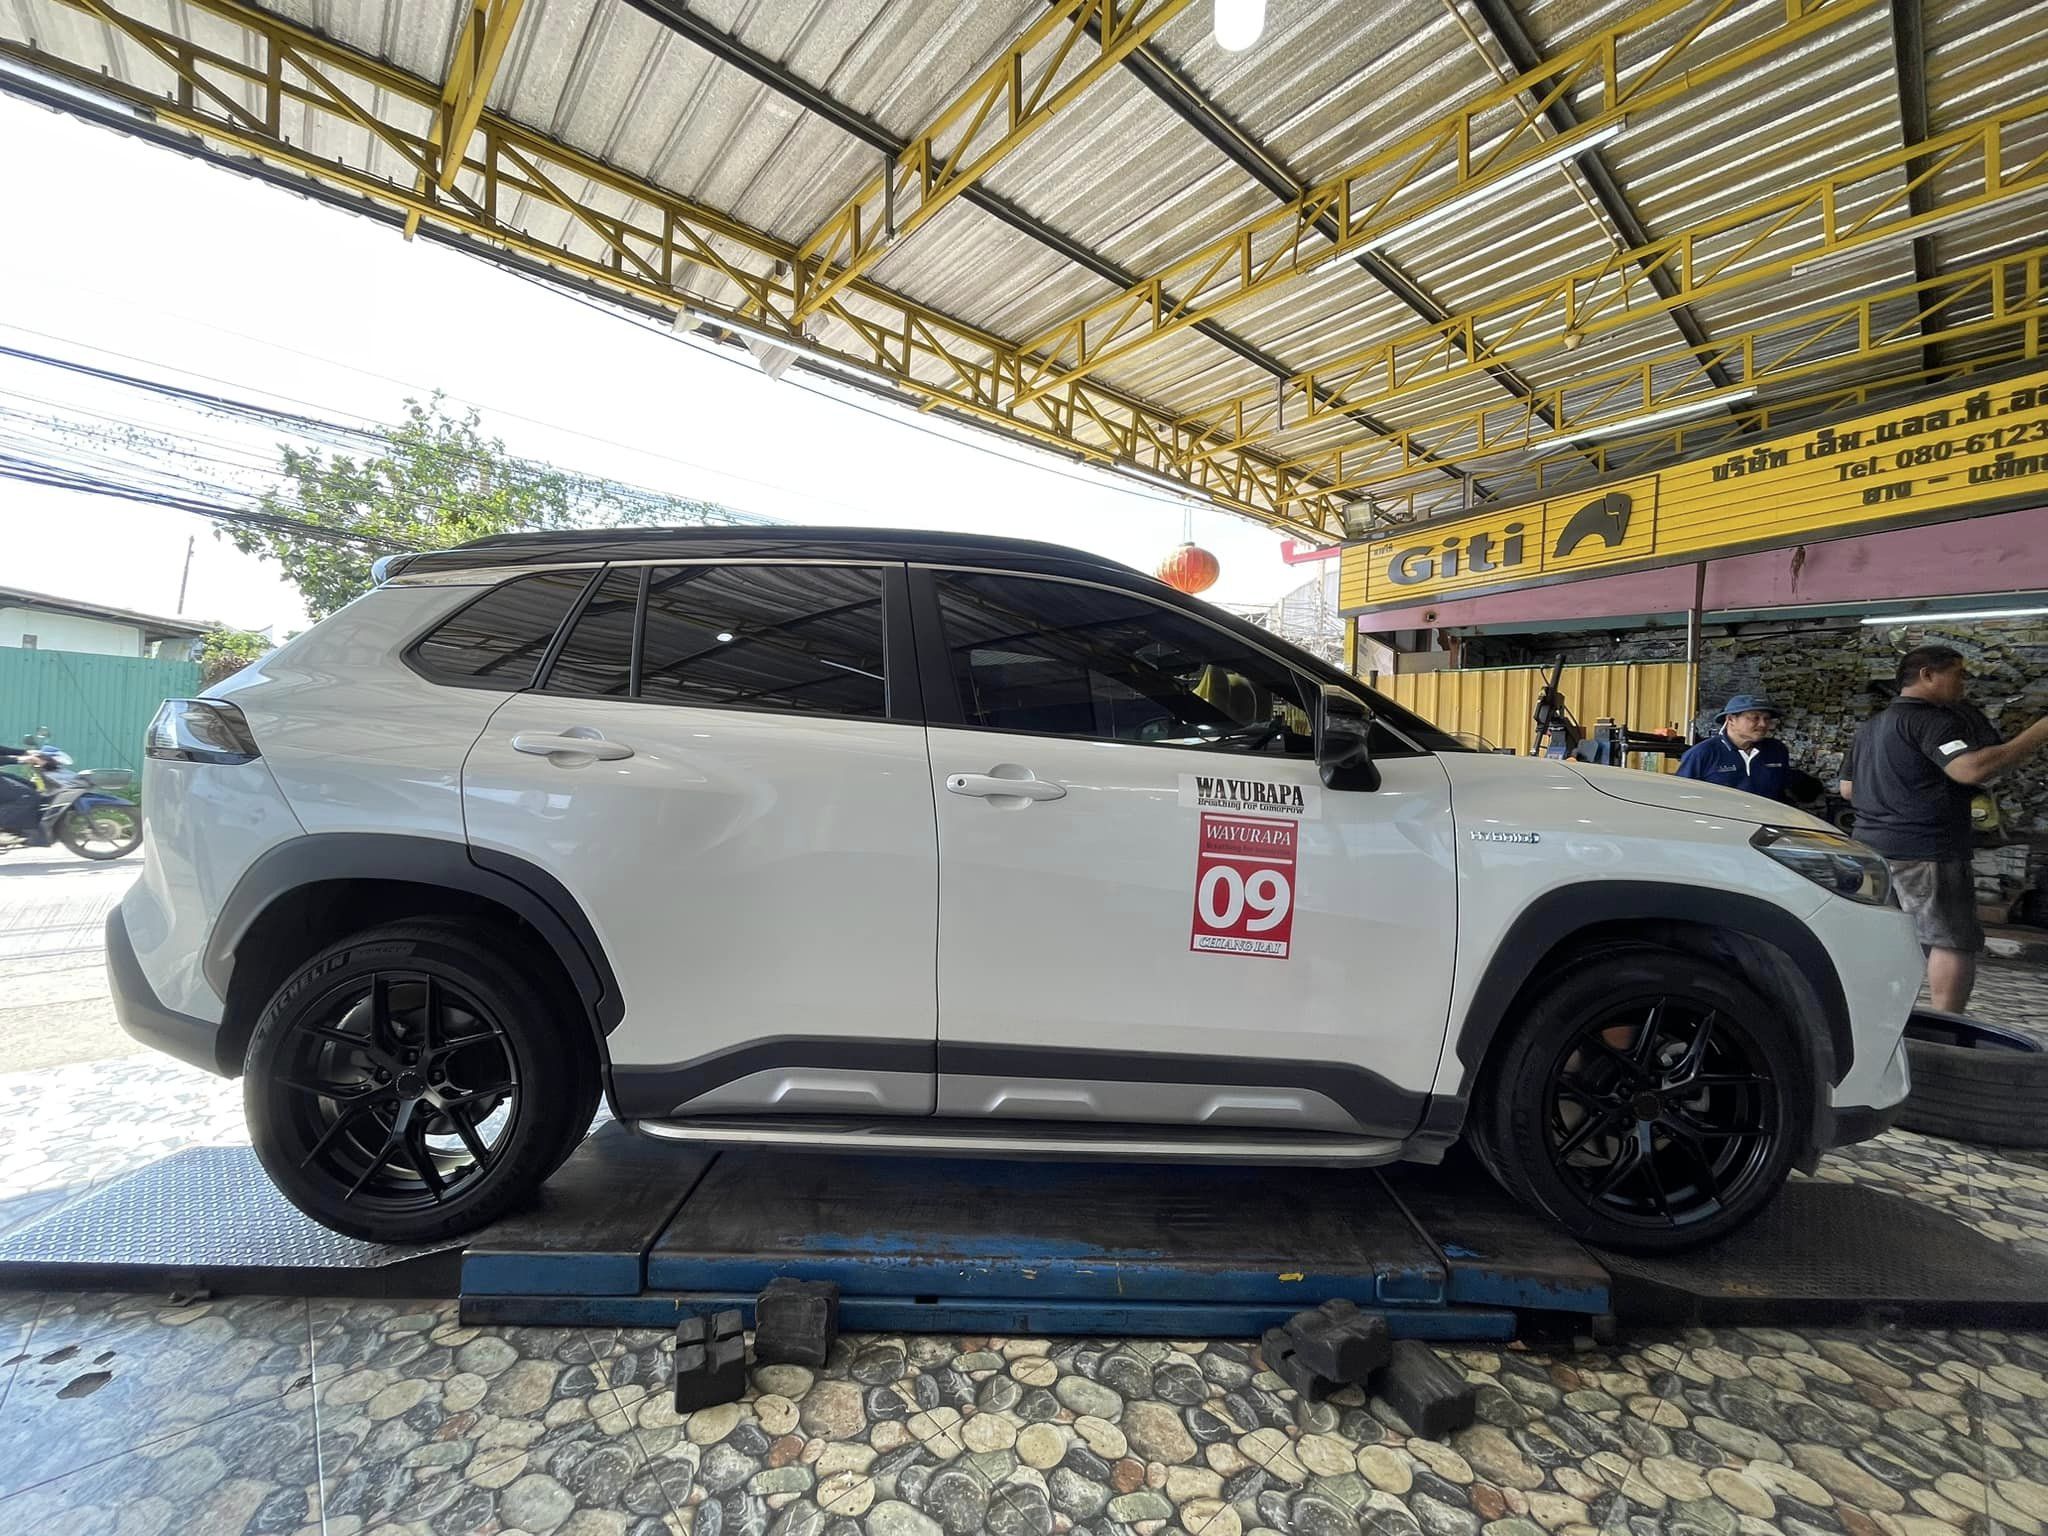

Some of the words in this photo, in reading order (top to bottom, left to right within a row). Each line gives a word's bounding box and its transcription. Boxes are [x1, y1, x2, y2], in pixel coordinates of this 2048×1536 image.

[1712, 448, 1788, 481] บริษัท
[1834, 456, 1886, 481] Tel.
[1388, 522, 1525, 585] Giti
[1196, 776, 1304, 806] WAYURAPA
[1206, 824, 1291, 846] WAYURAPA
[1198, 865, 1291, 932] 09
